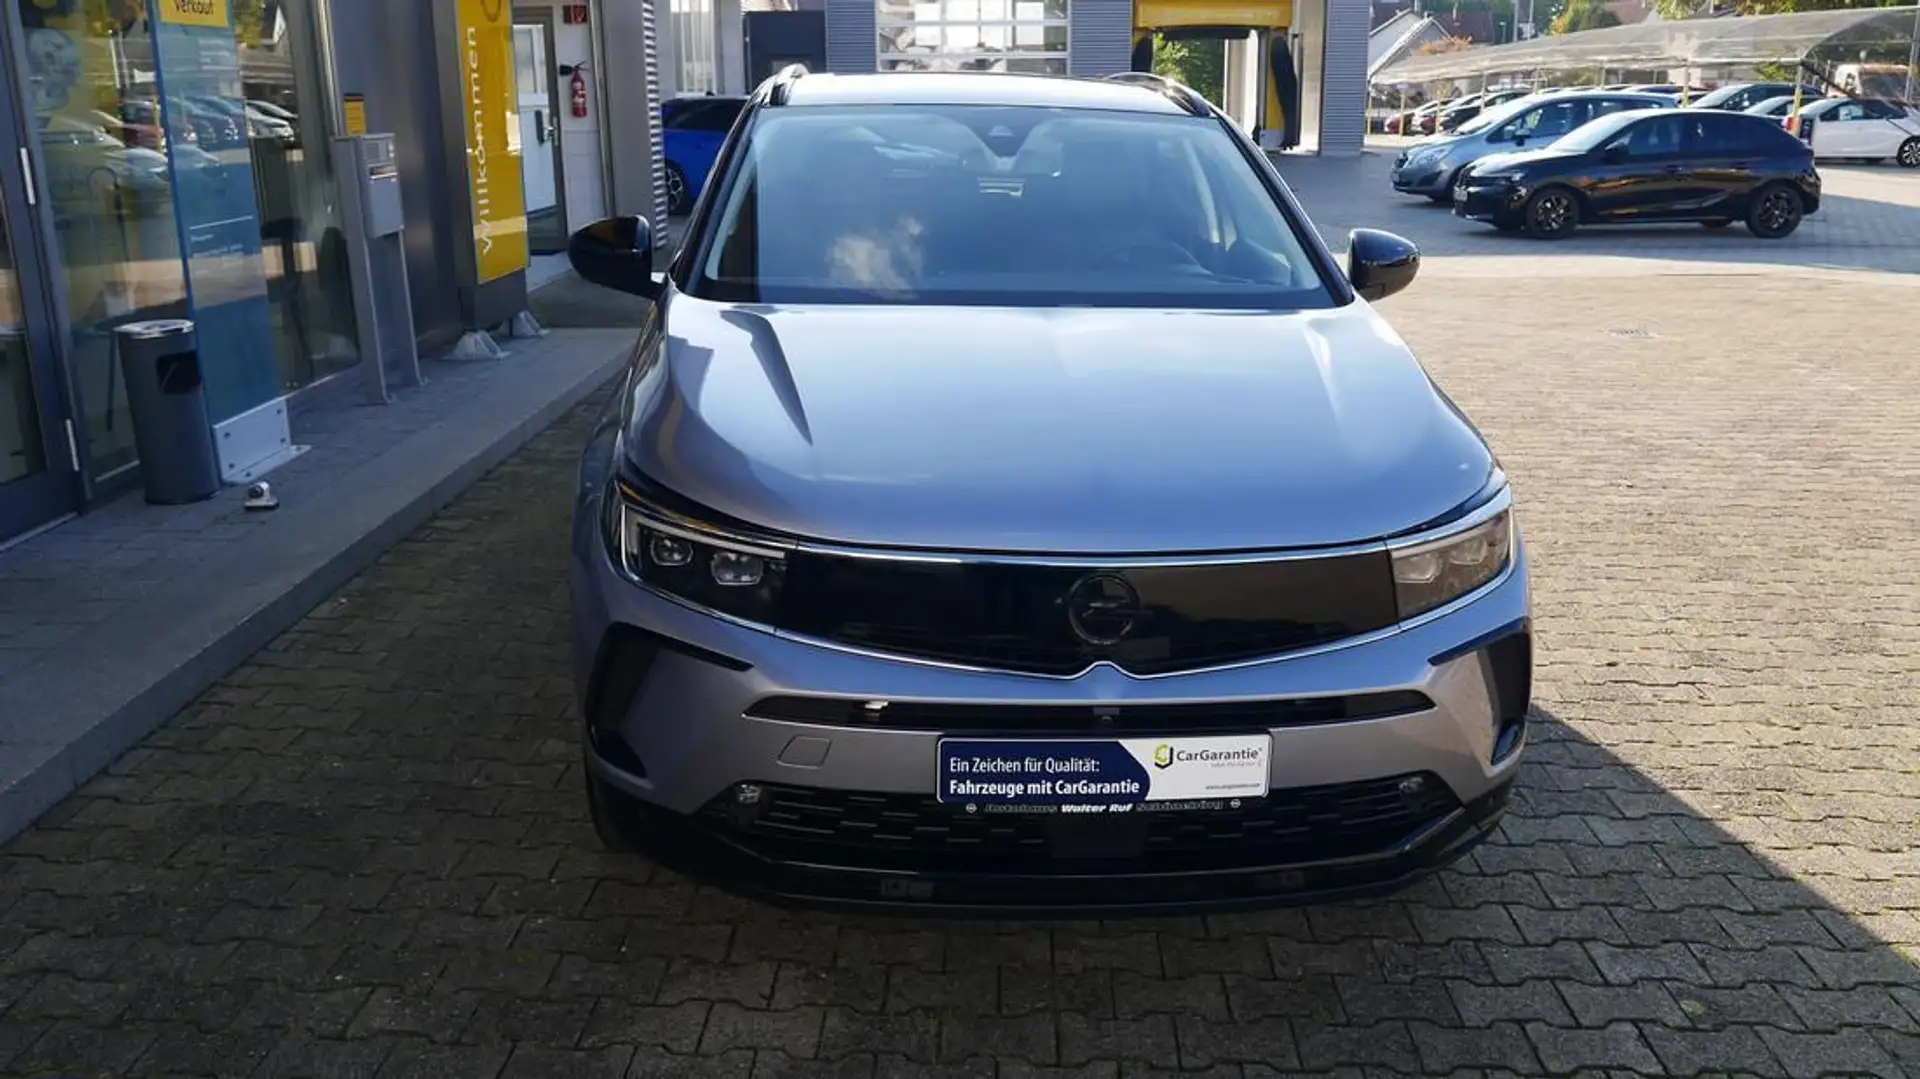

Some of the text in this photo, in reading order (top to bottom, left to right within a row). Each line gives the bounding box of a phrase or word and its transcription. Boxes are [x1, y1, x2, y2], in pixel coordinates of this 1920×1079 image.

[467, 27, 492, 256] Willkommen
[1176, 747, 1259, 761] CarGarantie
[950, 757, 1100, 773] Ein Zeichen für Qualität:
[950, 779, 1140, 798] Fahrzeuge mit CarGarantie
[1061, 803, 1106, 814] Walter
[1109, 803, 1133, 812] Ruf
